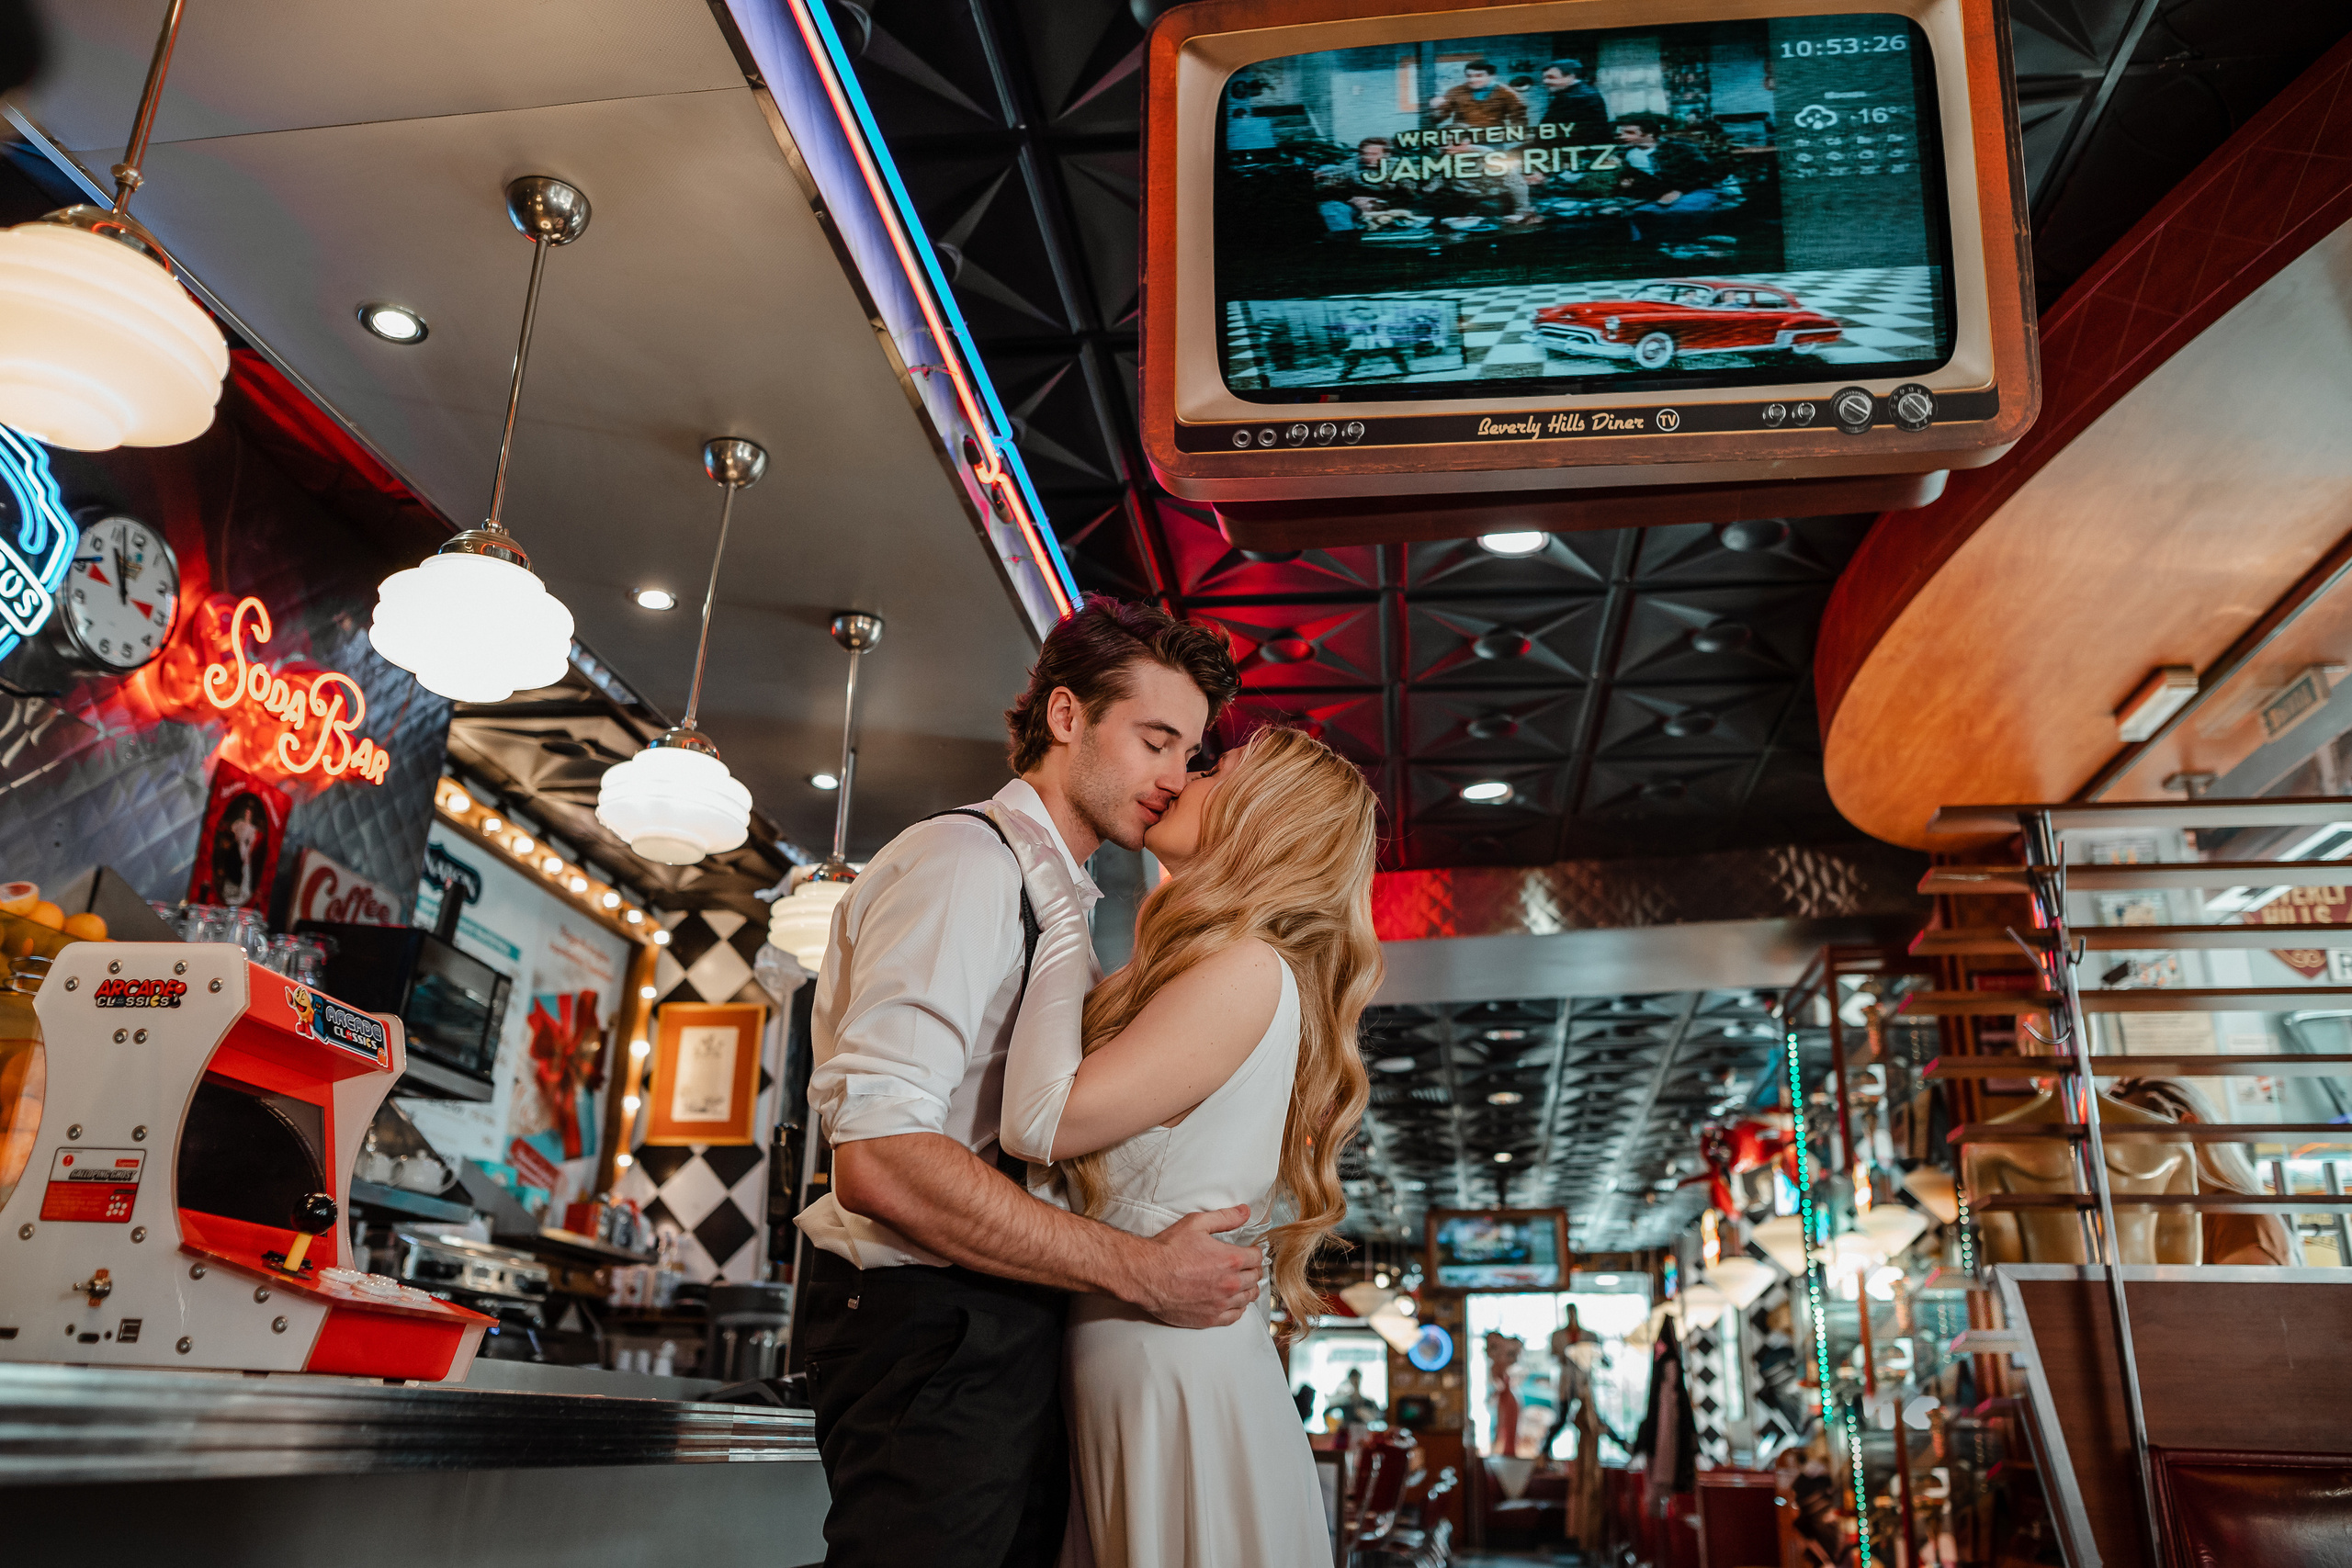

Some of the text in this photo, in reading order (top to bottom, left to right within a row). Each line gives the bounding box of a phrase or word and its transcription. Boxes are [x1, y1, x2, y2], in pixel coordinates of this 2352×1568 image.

[1781, 35, 1906, 58] 10:53:26
[1397, 122, 1576, 148] WRITTEN BY
[1362, 144, 1619, 184] JAMES RITZ
[1477, 412, 1676, 440] Beverly Hills Diner TV
[90, 535, 103, 551] 10
[98, 637, 110, 655] 6
[95, 979, 179, 998] ARCADE
[325, 1006, 383, 1042] ARCADE
